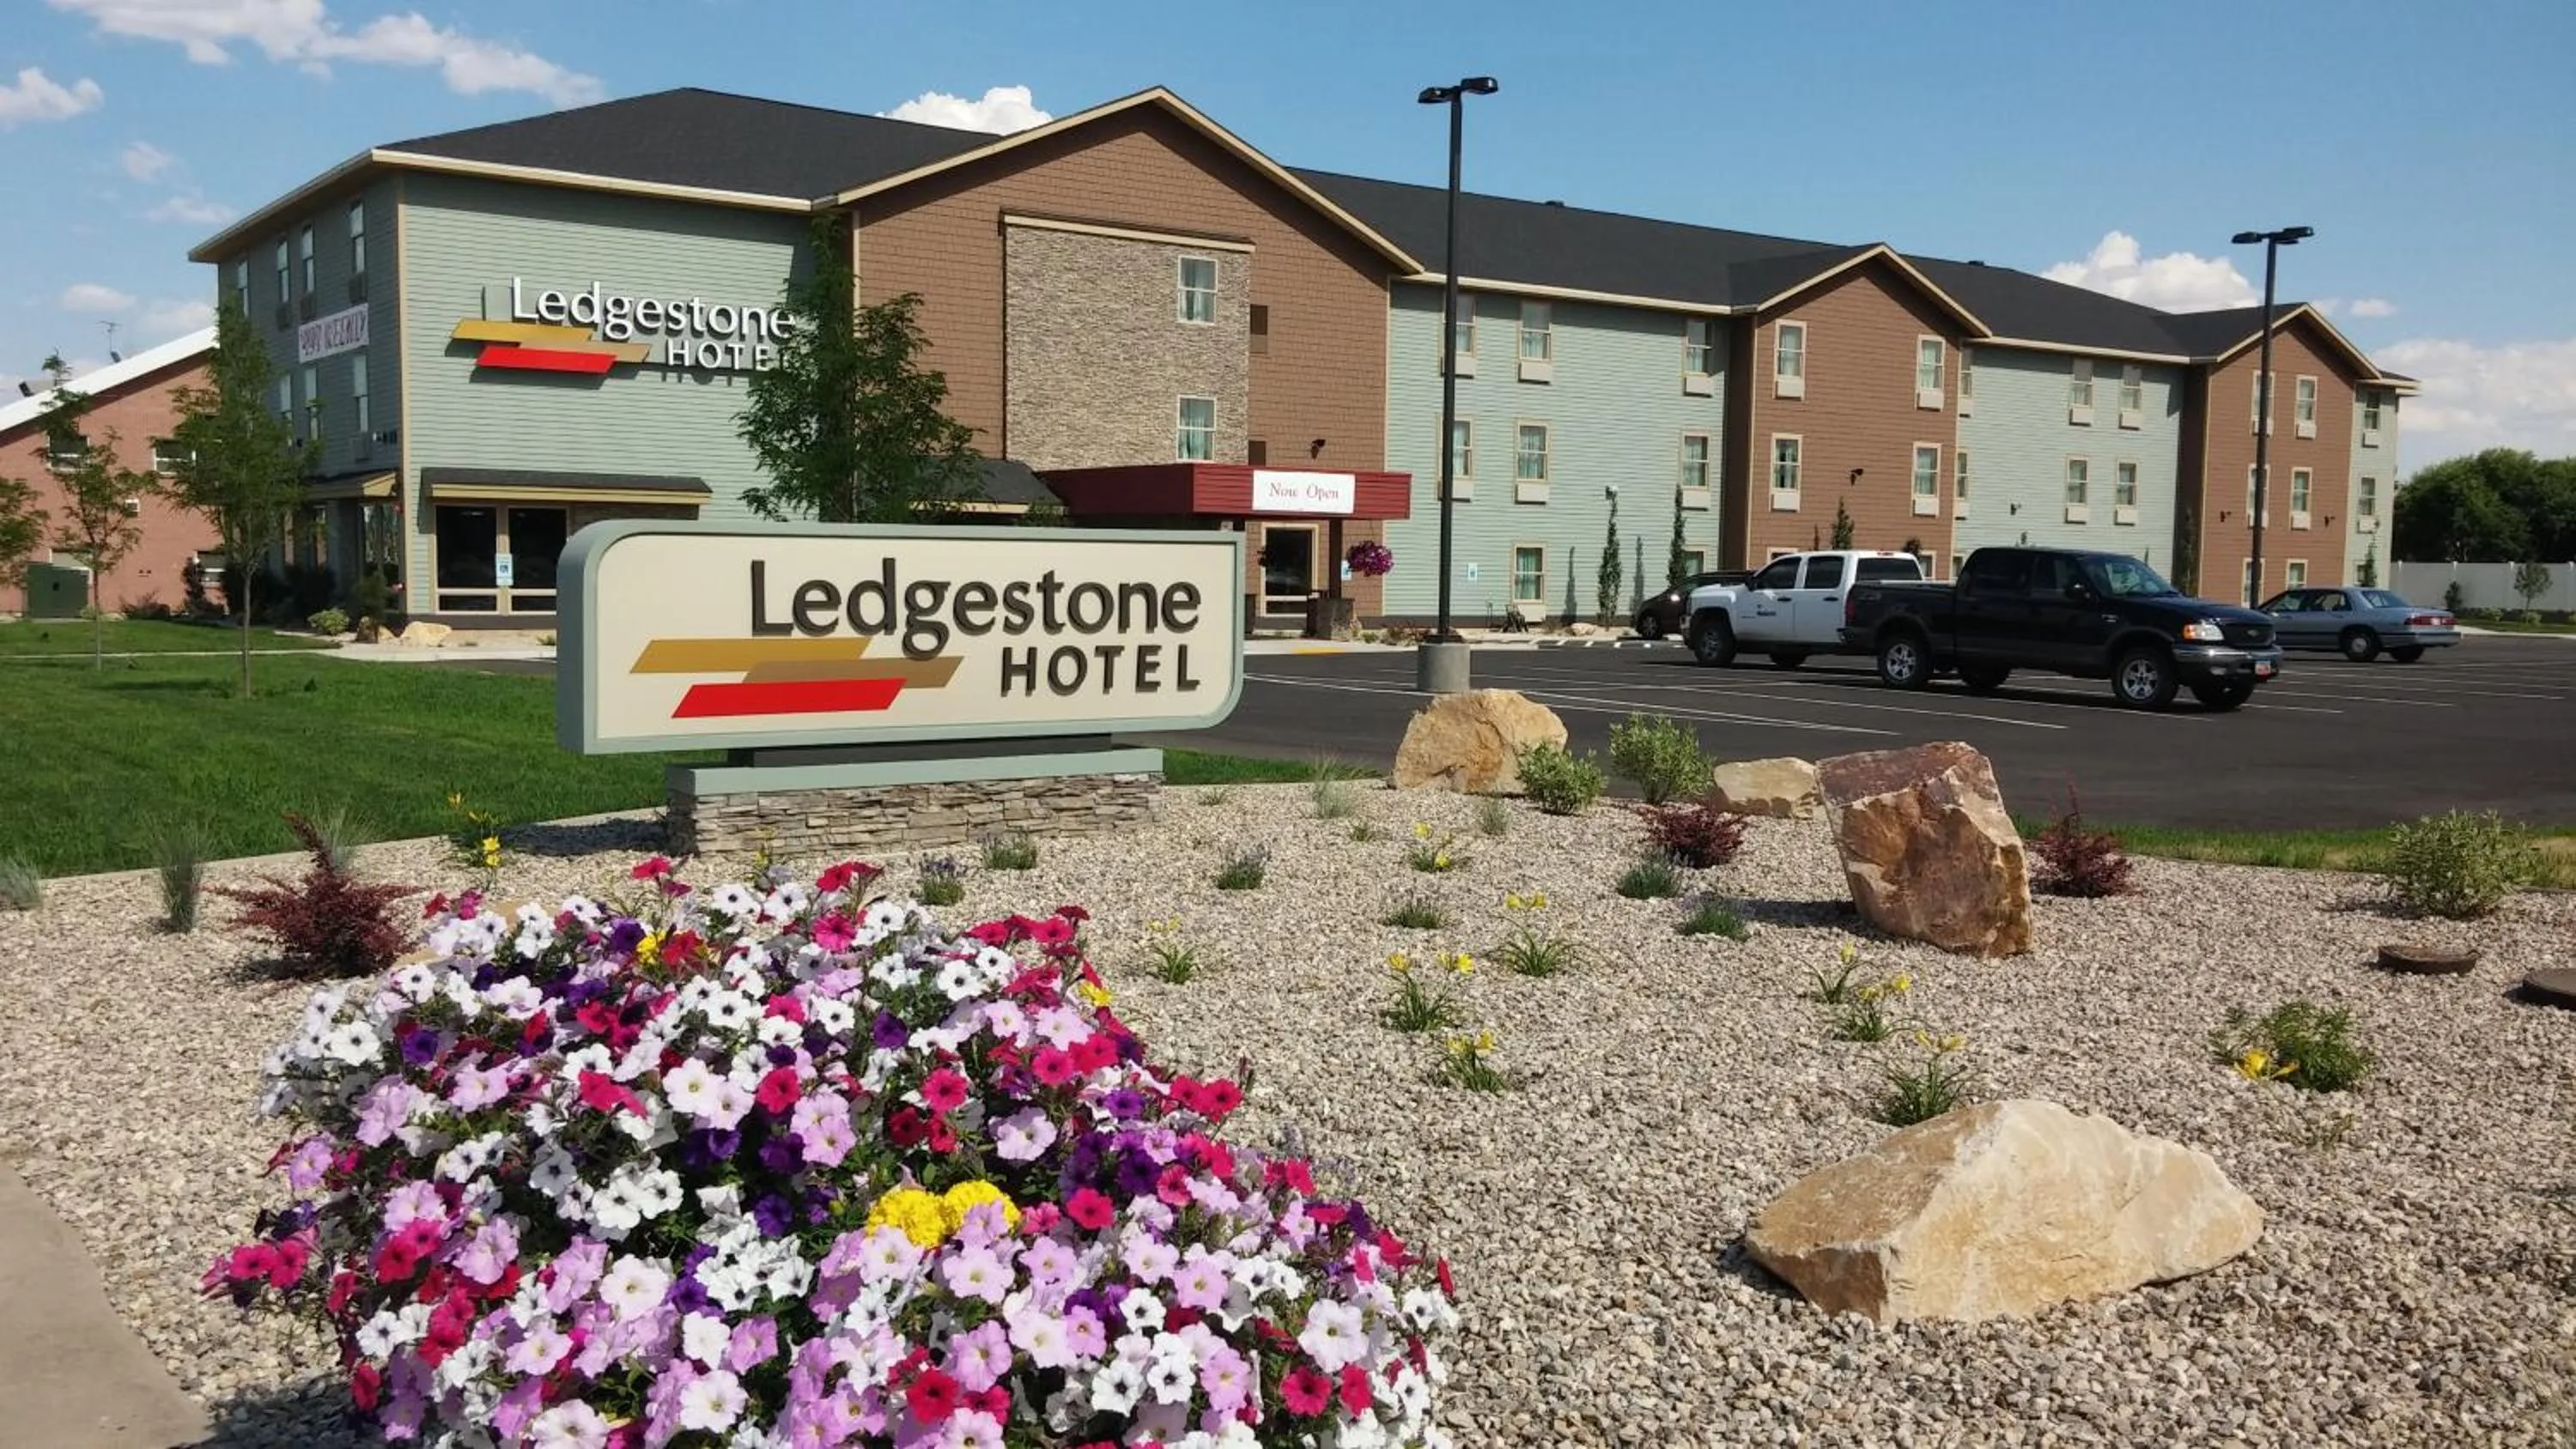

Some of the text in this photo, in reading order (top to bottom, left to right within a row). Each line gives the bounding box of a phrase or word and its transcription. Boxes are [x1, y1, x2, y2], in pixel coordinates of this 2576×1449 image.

[513, 276, 796, 340] Ledgestone
[666, 338, 792, 372] HOTE
[1267, 482, 1340, 502] Now Open
[750, 557, 1201, 662] Ledgestone
[1000, 644, 1200, 697] HOTEL
